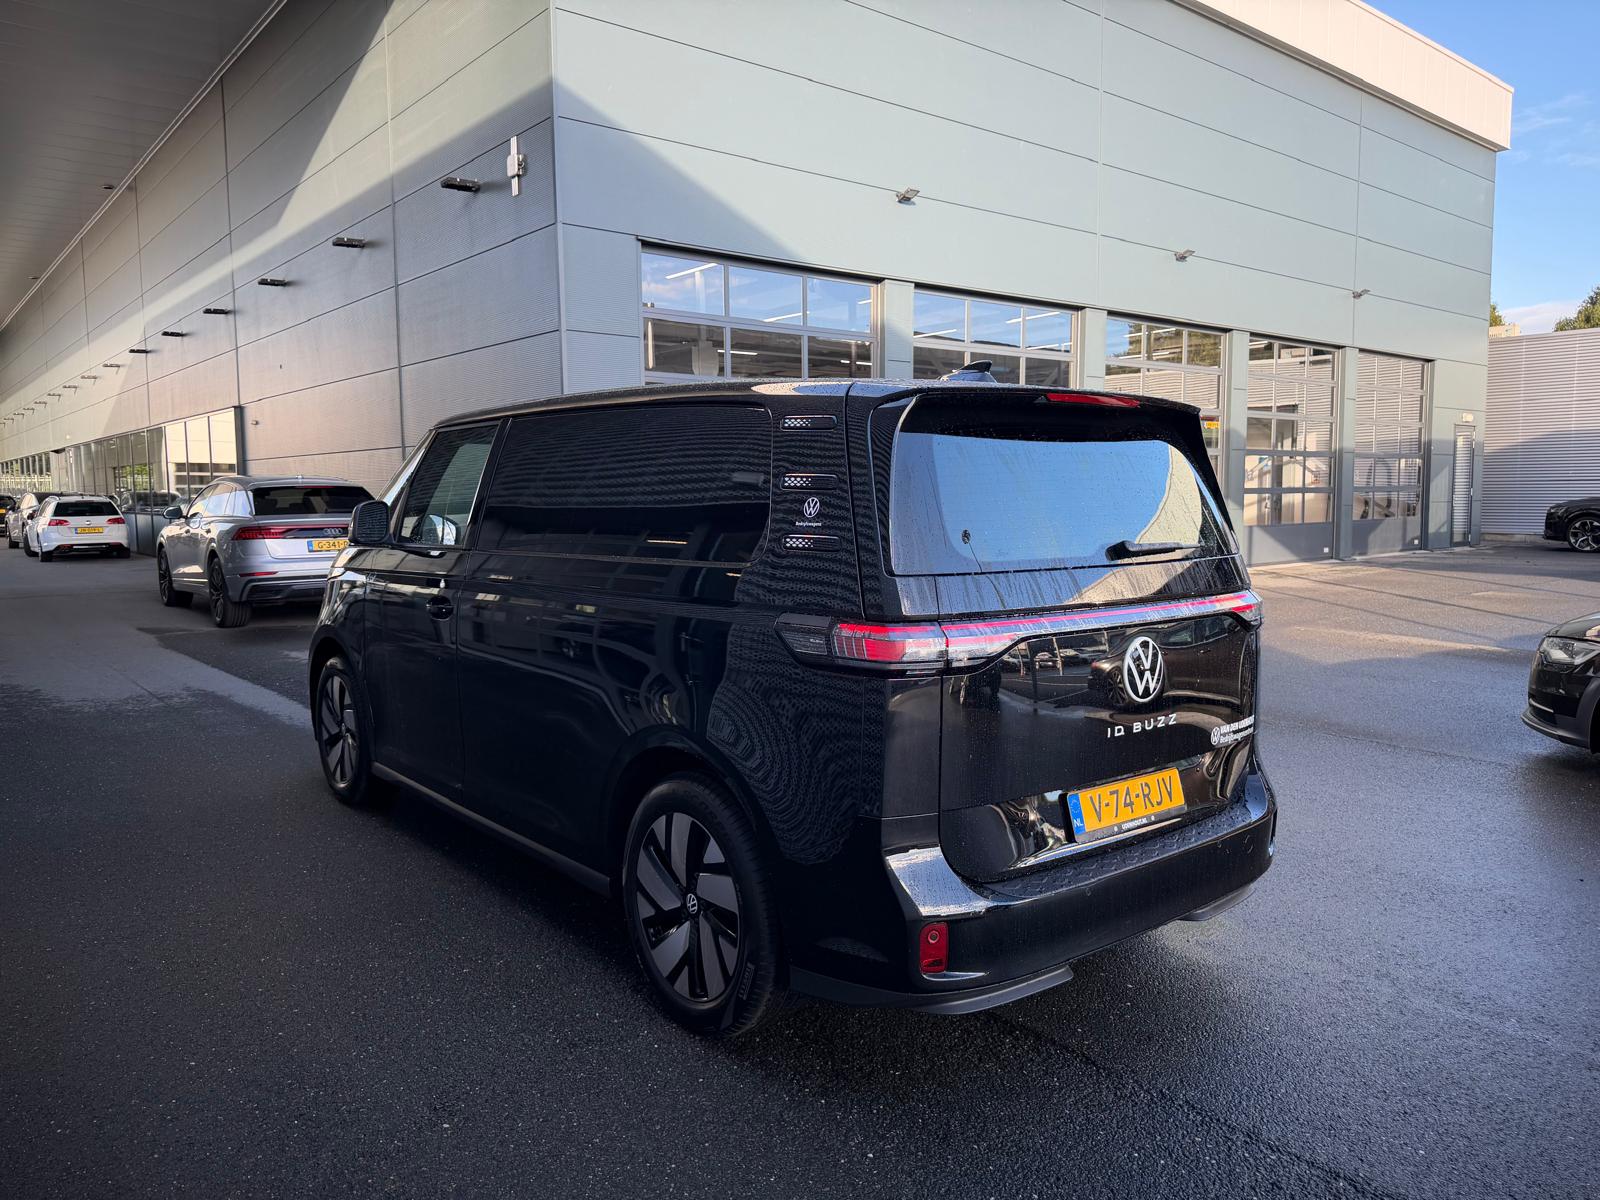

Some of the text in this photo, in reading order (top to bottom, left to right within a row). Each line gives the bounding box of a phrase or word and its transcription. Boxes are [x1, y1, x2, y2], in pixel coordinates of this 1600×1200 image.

[1133, 713, 1177, 733] BUZZ
[1089, 775, 1173, 823] V-74-RJV
[1073, 818, 1084, 828] NL
